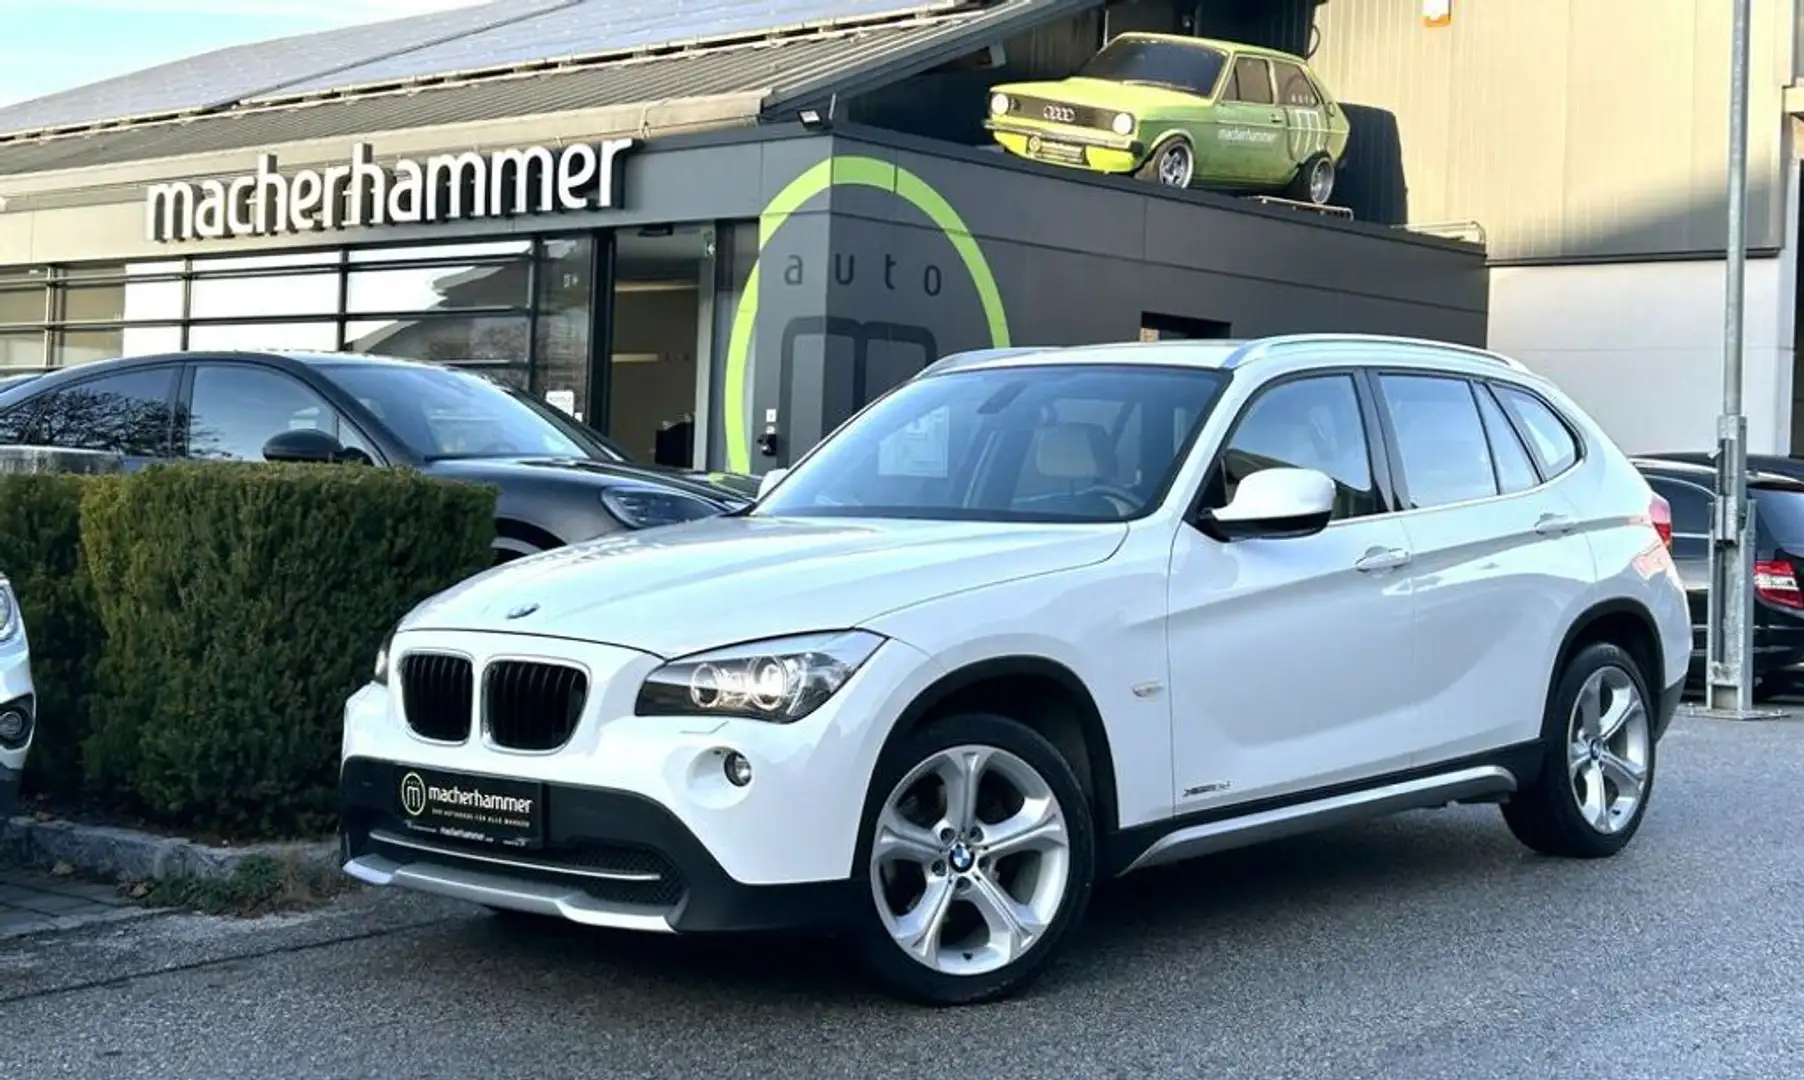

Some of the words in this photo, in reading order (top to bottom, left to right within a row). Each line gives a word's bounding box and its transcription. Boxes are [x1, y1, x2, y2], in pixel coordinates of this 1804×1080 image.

[145, 139, 634, 241] macherhammer
[784, 253, 941, 296] auto
[428, 785, 534, 814] macherhammer
